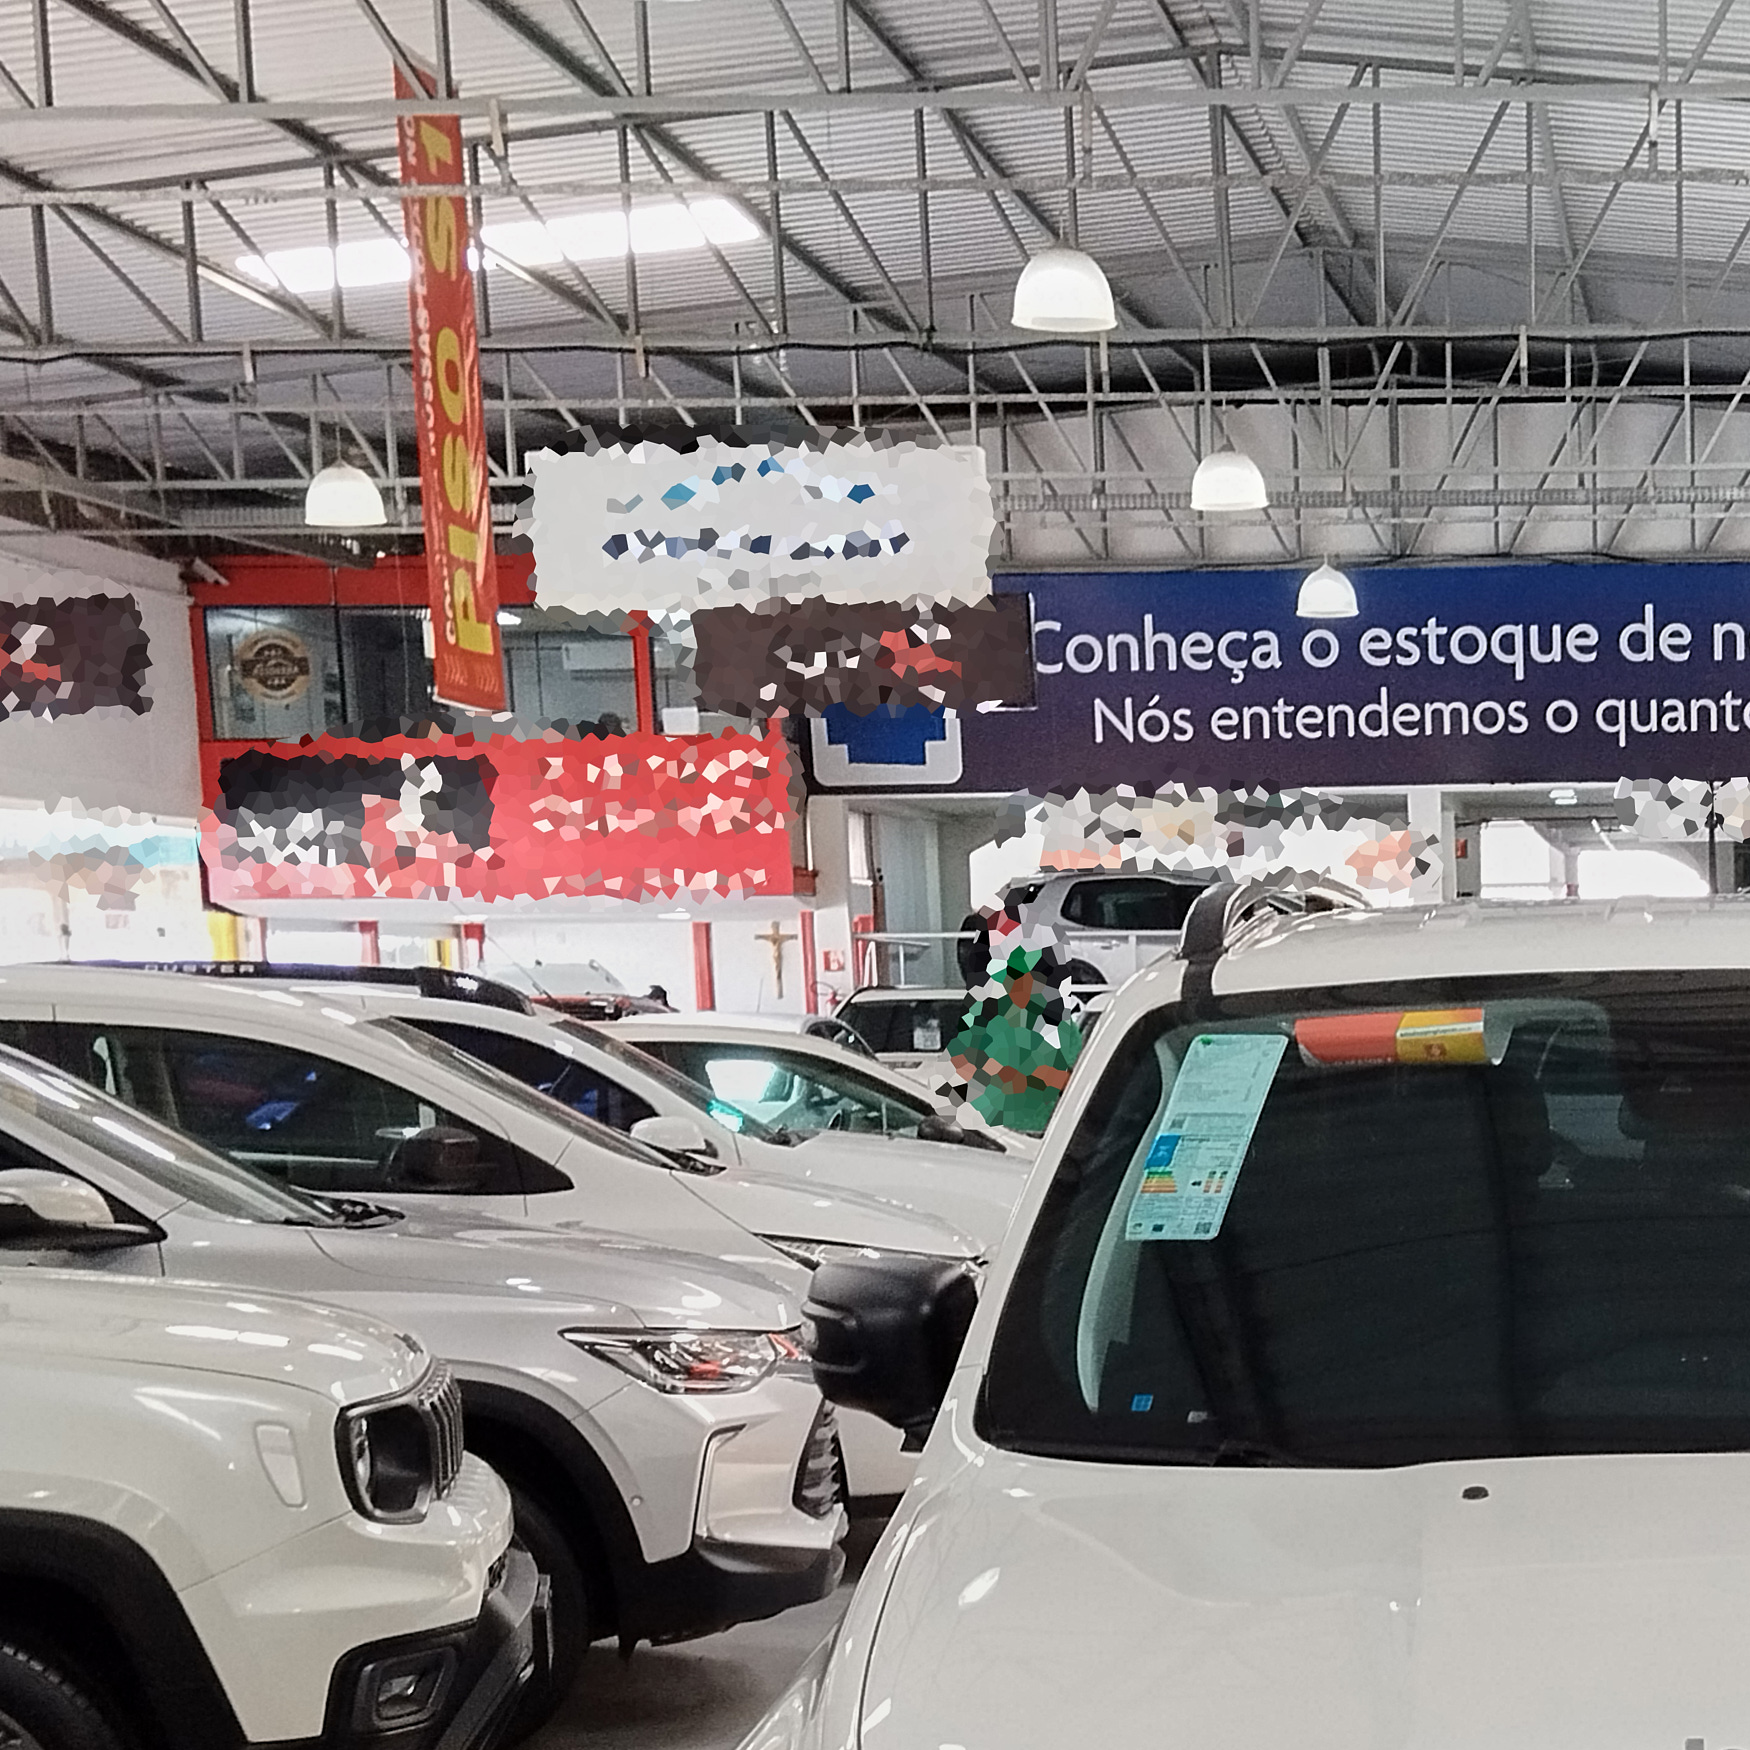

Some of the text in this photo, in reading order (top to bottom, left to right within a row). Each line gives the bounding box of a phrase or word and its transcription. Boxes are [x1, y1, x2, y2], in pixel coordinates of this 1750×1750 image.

[436, 327, 495, 656] PISO
[1034, 613, 1283, 684] Conheça
[1301, 628, 1340, 668] o
[1359, 617, 1600, 681] estoque
[1619, 603, 1693, 662] de
[1094, 695, 1195, 744] Nós
[1211, 686, 1529, 741] entendemos
[1545, 699, 1579, 734] o
